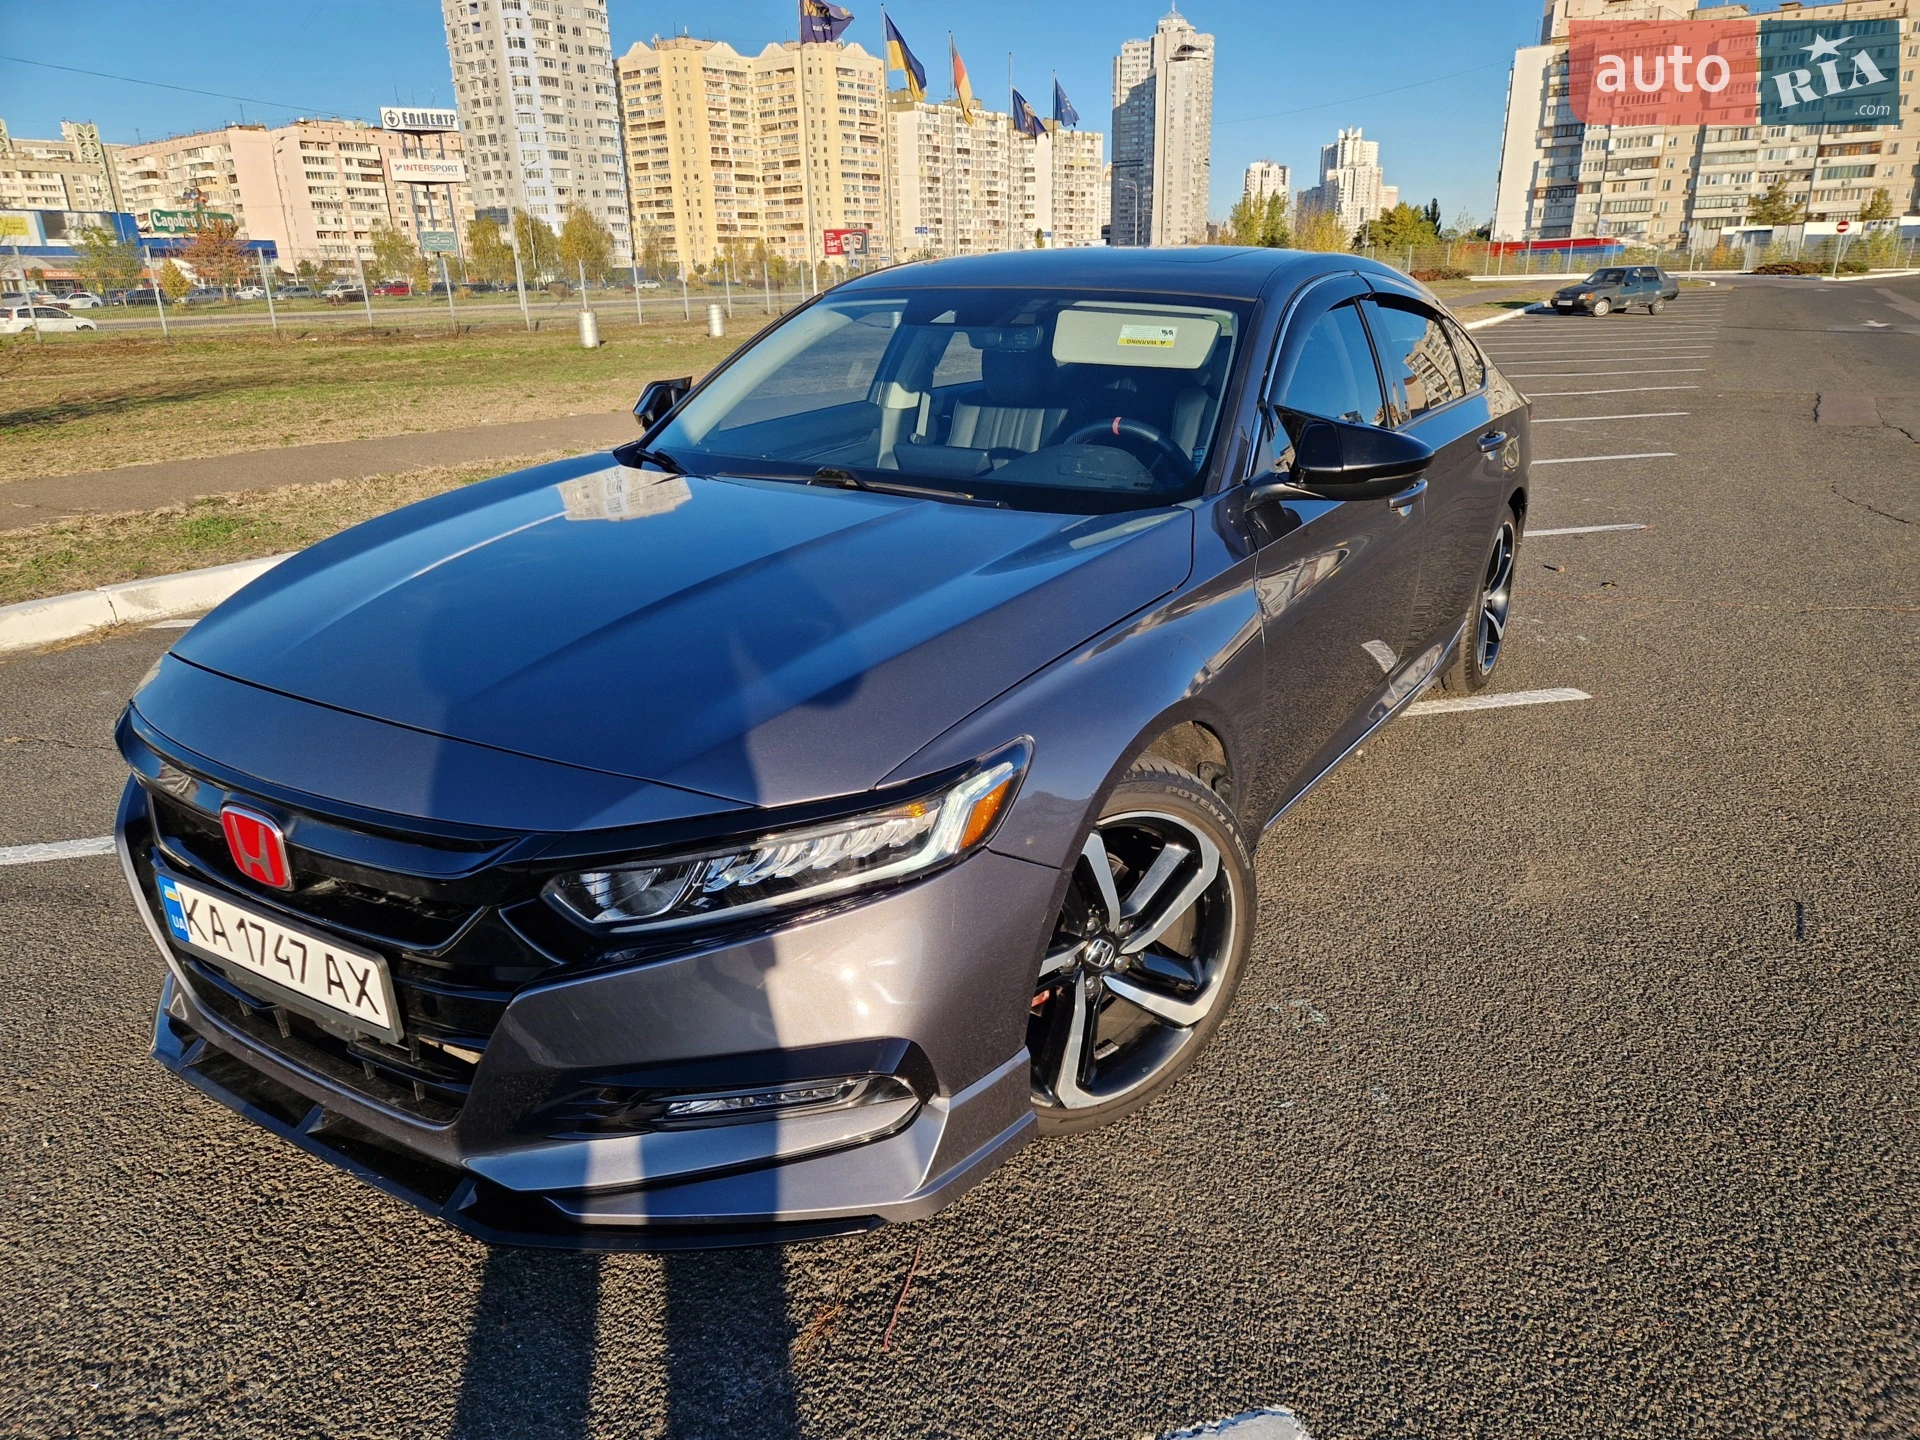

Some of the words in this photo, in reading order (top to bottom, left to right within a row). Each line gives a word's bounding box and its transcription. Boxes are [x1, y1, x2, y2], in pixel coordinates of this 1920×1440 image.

[403, 164, 459, 173] INTERSPORT
[1165, 785, 1234, 835] POTENZA
[172, 914, 188, 932] UA
[236, 917, 308, 985] 1747
[325, 952, 381, 1016] AX
